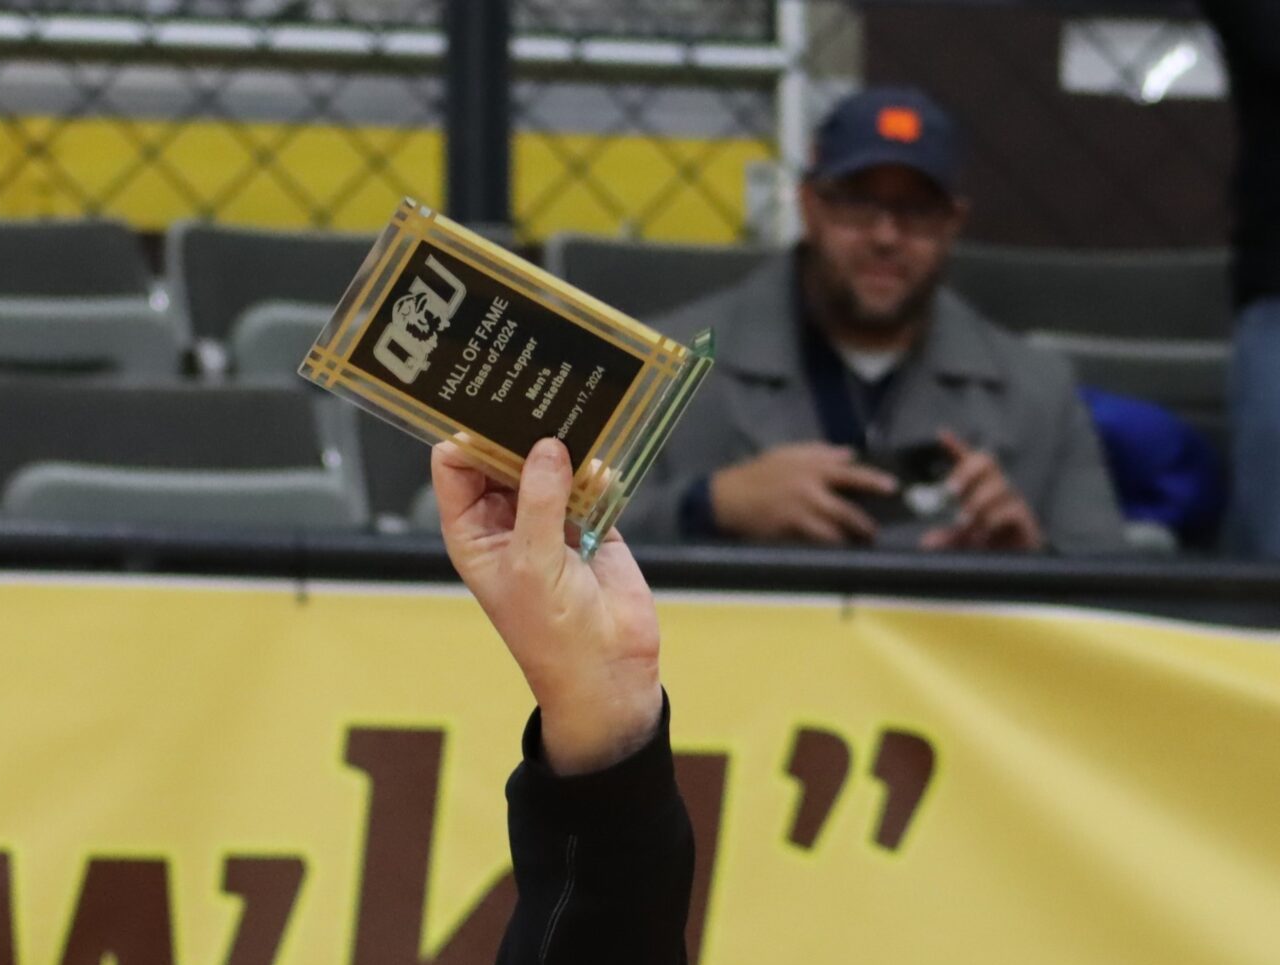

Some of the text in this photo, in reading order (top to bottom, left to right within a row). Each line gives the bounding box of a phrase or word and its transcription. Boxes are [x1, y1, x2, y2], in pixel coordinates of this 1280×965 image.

[438, 296, 509, 401] HALL OF FAME
[465, 319, 518, 396] Class of 2024
[490, 336, 538, 403] Tom Lepper
[525, 367, 552, 400] Men's
[531, 361, 572, 419] Basketball
[577, 391, 593, 404] 17,
[586, 365, 606, 390] 2024
